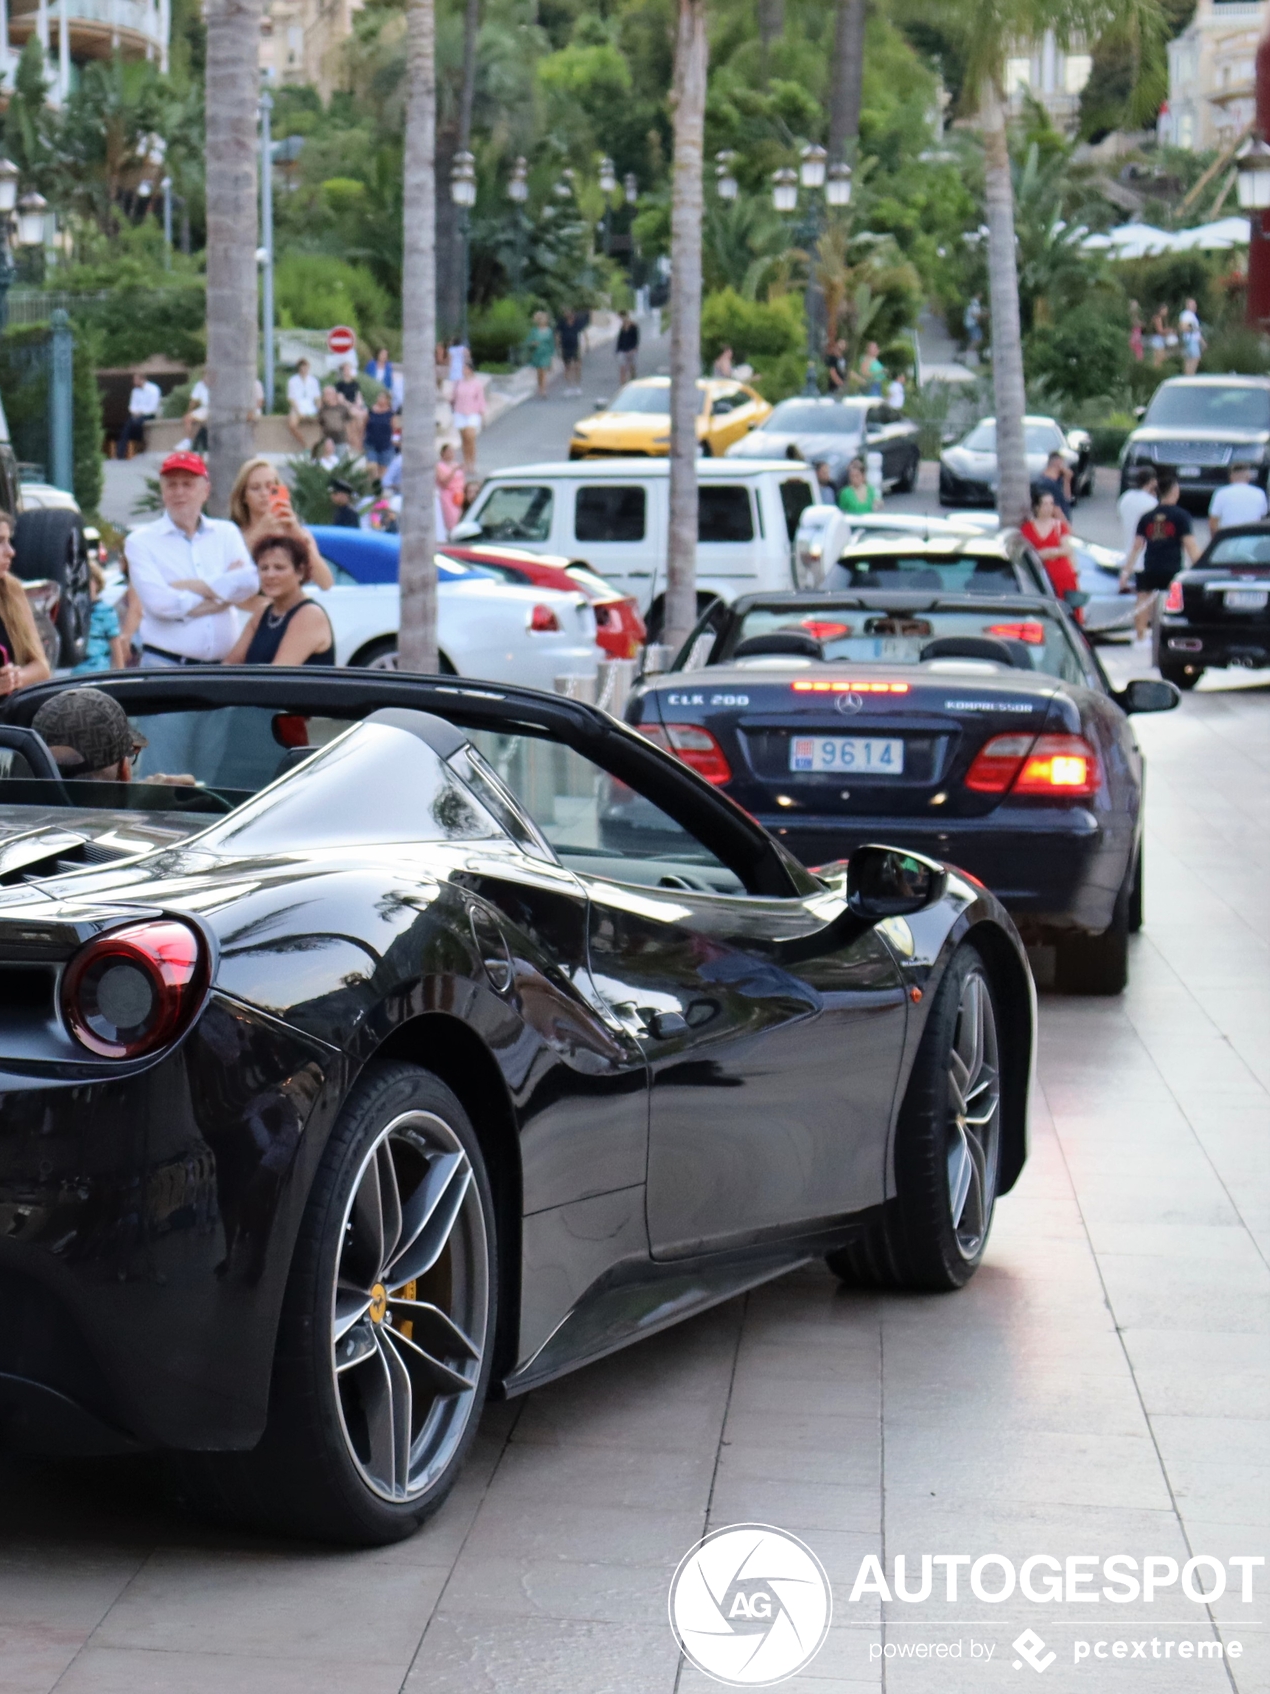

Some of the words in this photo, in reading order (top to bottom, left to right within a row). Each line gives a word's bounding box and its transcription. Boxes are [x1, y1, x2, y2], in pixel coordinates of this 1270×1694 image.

[668, 694, 707, 707] CLK
[710, 694, 749, 707] 200
[944, 699, 1034, 713] KOMPRESSOR
[821, 740, 894, 766] 9614
